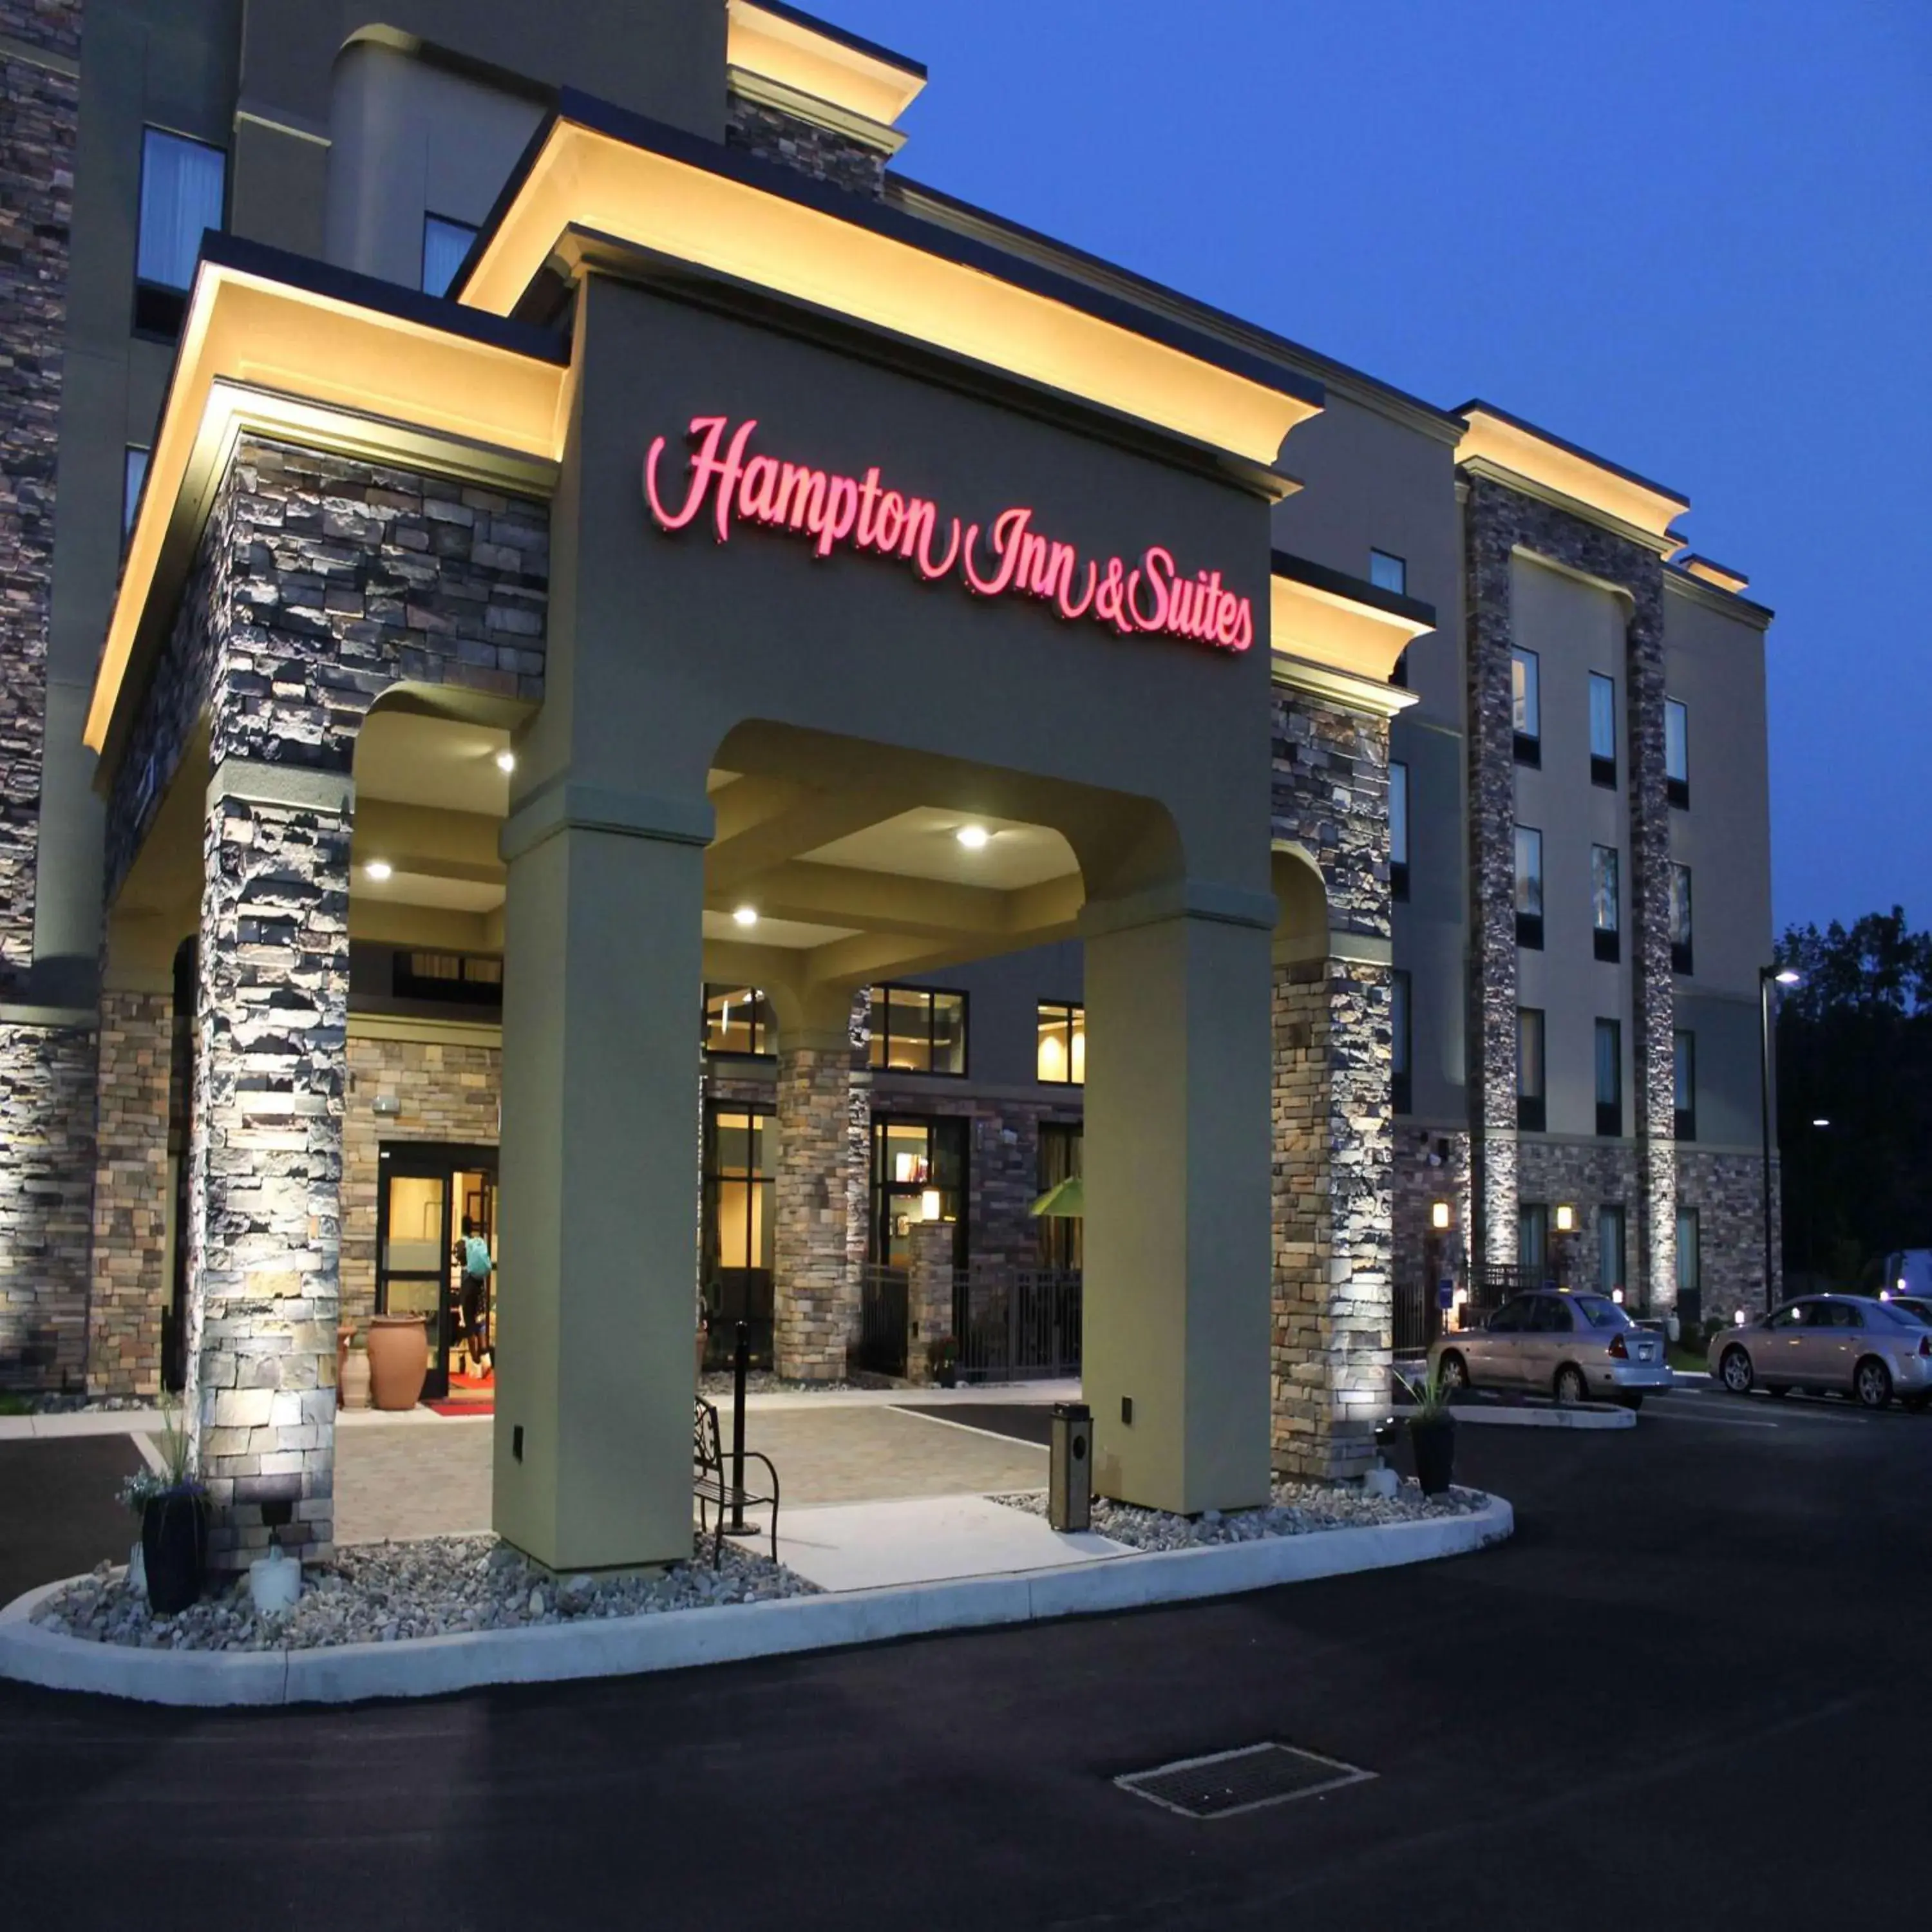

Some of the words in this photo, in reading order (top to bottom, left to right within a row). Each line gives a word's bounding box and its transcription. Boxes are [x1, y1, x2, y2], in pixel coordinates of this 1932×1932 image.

[646, 417, 961, 578] Hampton
[963, 508, 1097, 618] Inn
[1095, 557, 1133, 632] &
[1127, 546, 1253, 650] Suites
